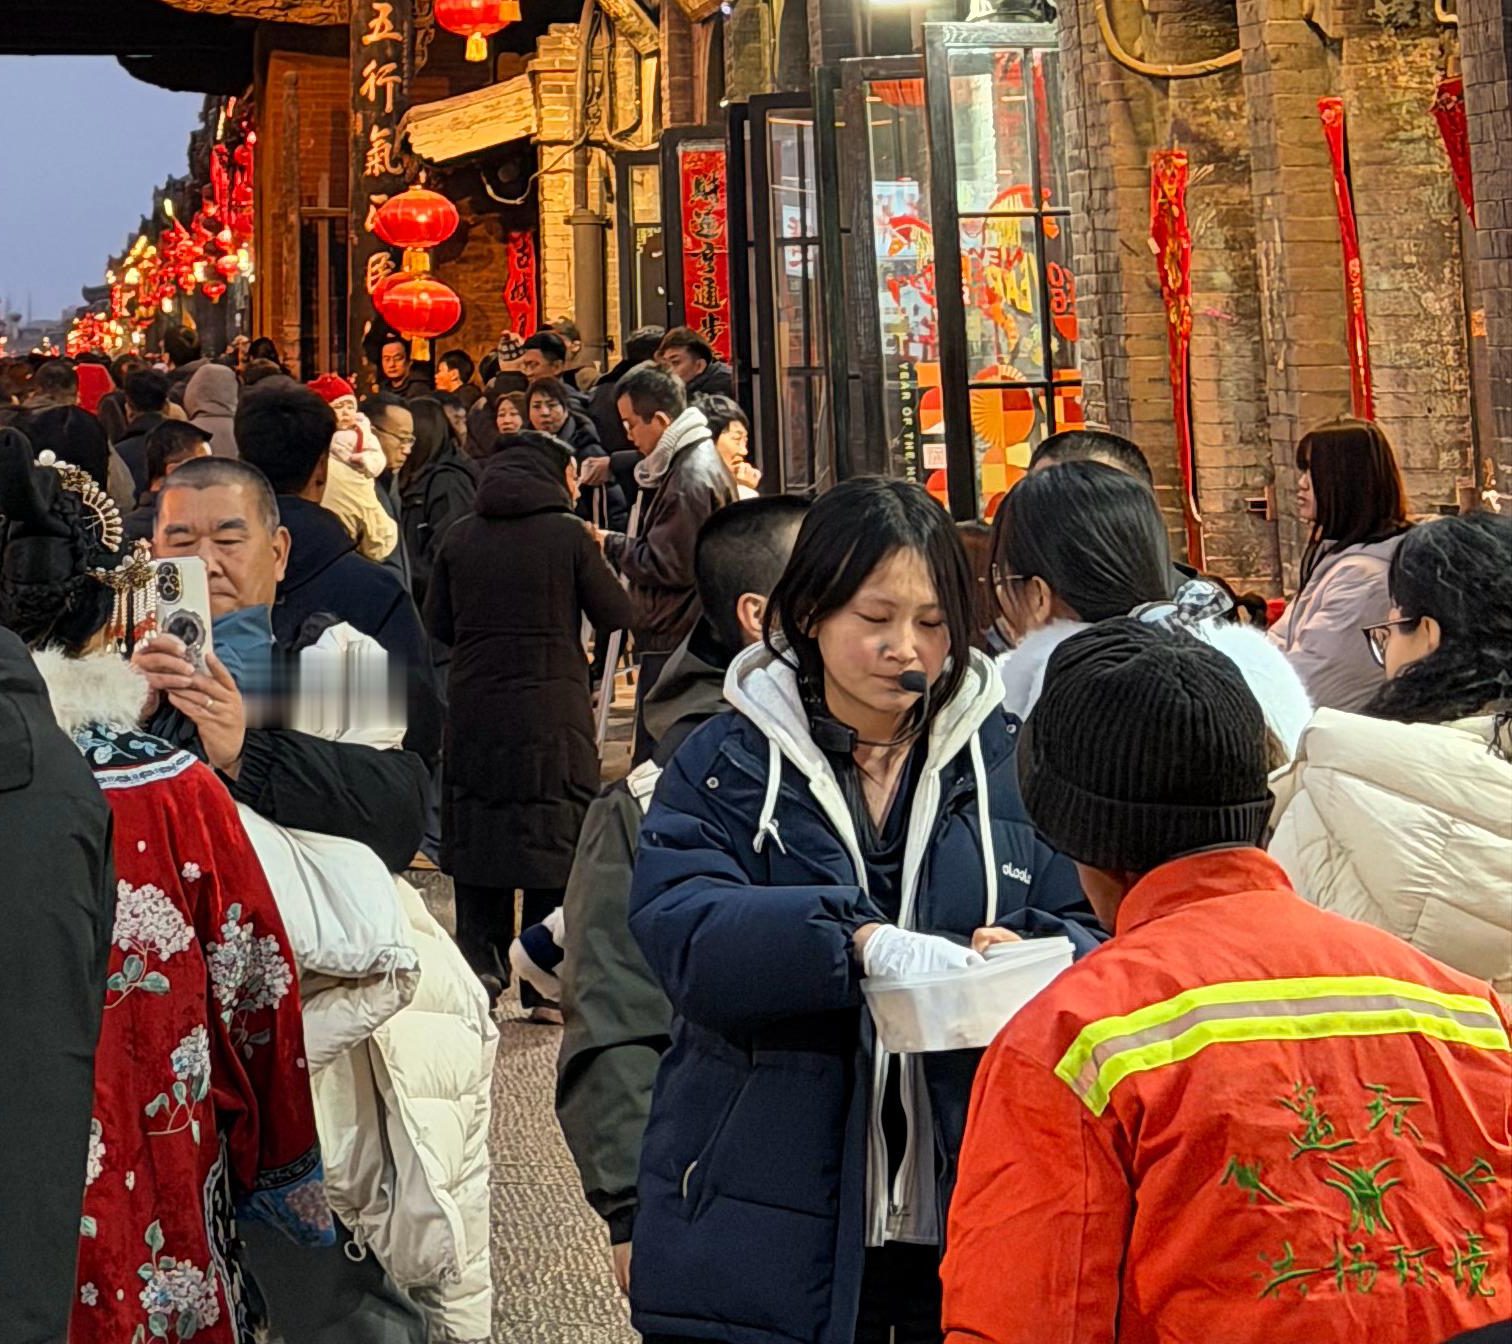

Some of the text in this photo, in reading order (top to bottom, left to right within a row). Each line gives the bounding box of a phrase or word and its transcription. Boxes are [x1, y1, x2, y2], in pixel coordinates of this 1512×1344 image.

[898, 362, 912, 400] YEAR
[901, 406, 914, 426] OF
[903, 431, 916, 460] THE
